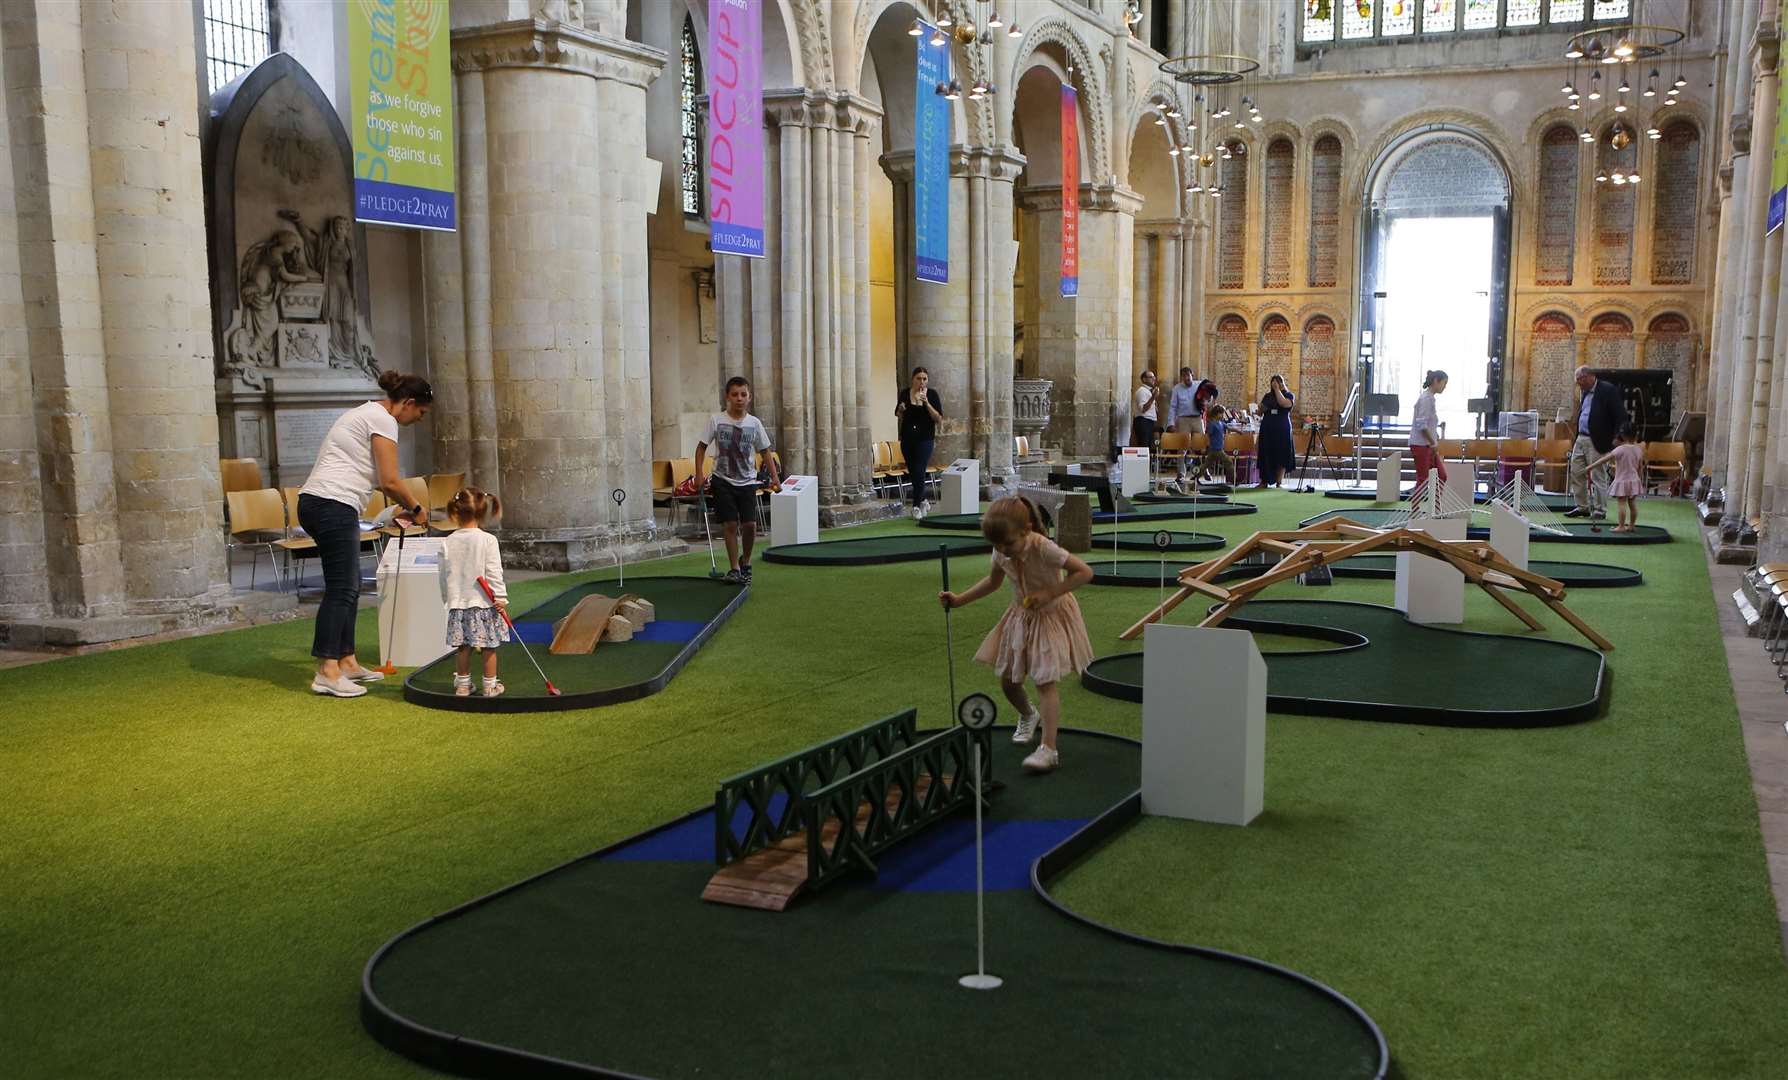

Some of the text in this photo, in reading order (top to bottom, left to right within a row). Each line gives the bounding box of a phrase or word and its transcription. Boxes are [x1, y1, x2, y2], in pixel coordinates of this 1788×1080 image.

[369, 90, 442, 118] as we forgive
[366, 113, 442, 142] those who sin
[711, 11, 740, 224] SIDCUP
[387, 144, 443, 167] against us.
[359, 194, 449, 219] #PLEDGE2PRAY
[713, 231, 762, 250] #PLEDGE2PRAY
[971, 708, 985, 725] 9
